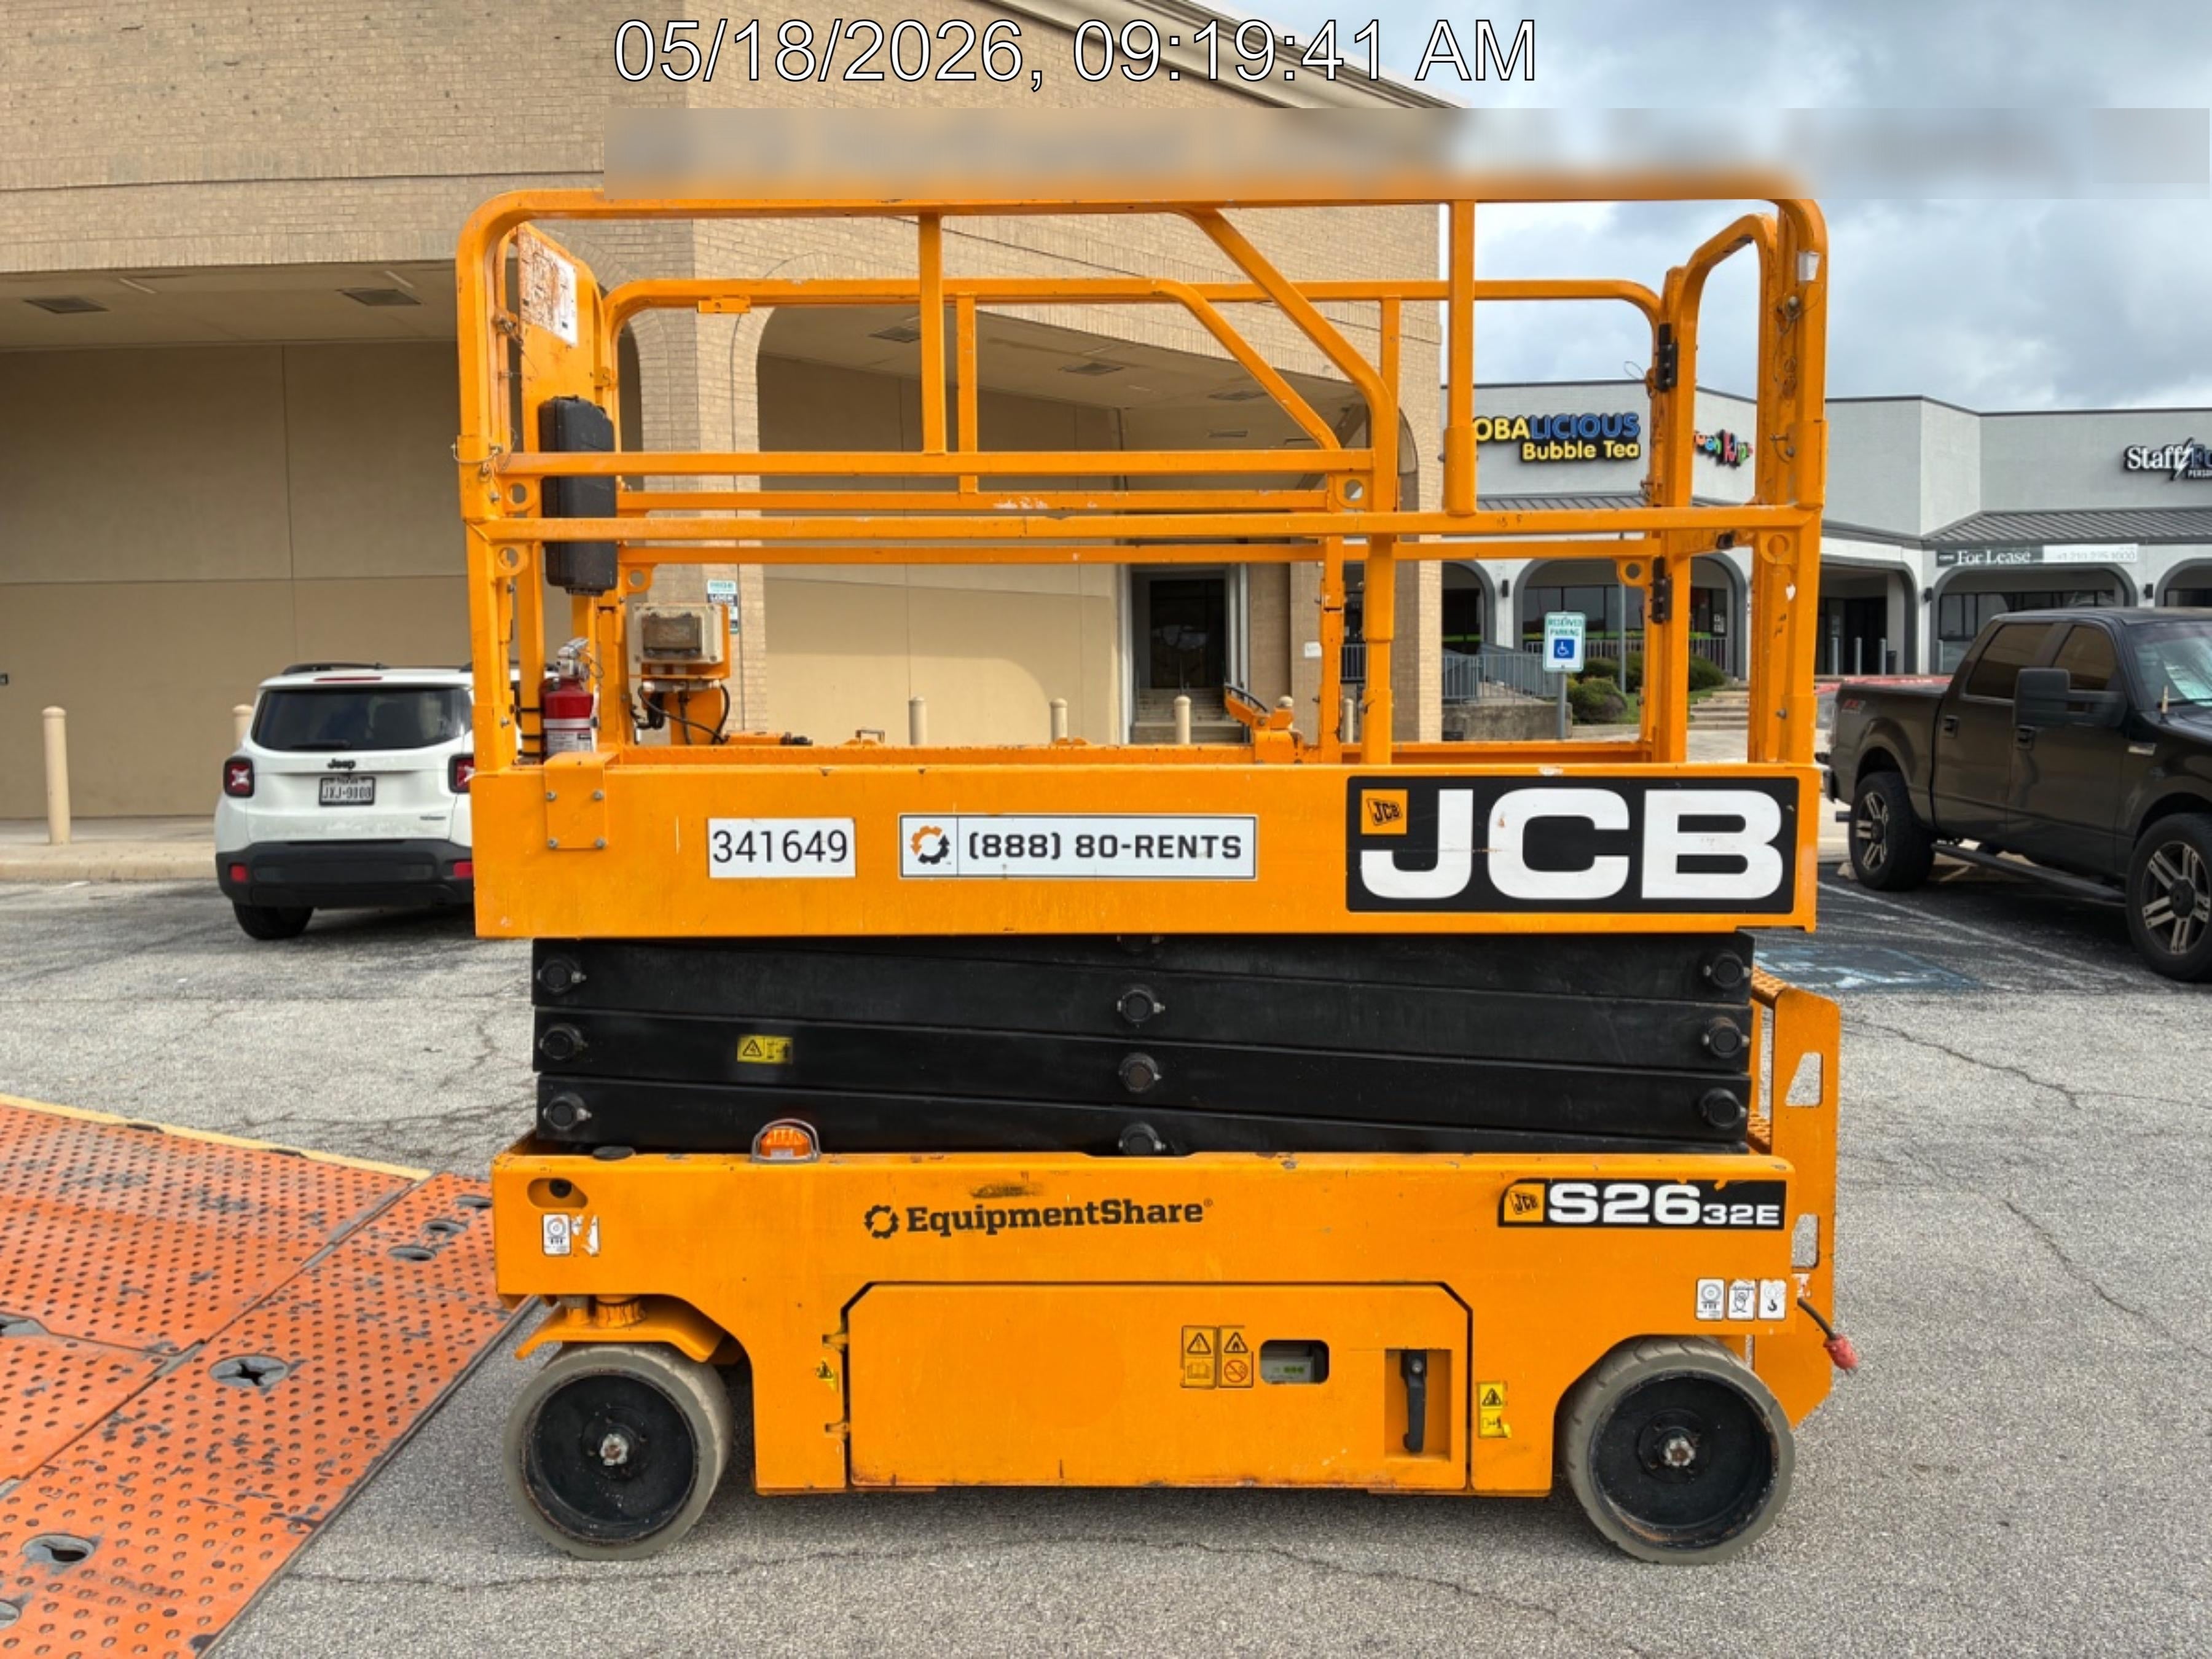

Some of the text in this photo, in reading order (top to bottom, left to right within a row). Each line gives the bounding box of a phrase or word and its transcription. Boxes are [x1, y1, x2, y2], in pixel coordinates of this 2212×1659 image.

[1473, 413, 1640, 441] OBALICIOUS
[1523, 440, 1640, 460] Bubble Tea
[1957, 549, 1983, 565] For
[1986, 549, 2031, 565] Lease
[327, 758, 356, 771] Jeep
[1373, 800, 1400, 822] JCB
[713, 830, 847, 863] 341649
[969, 833, 1241, 860] (888) 80-RENTS
[1361, 789, 1783, 899] JCB
[1548, 1183, 1780, 1225] S26 32E
